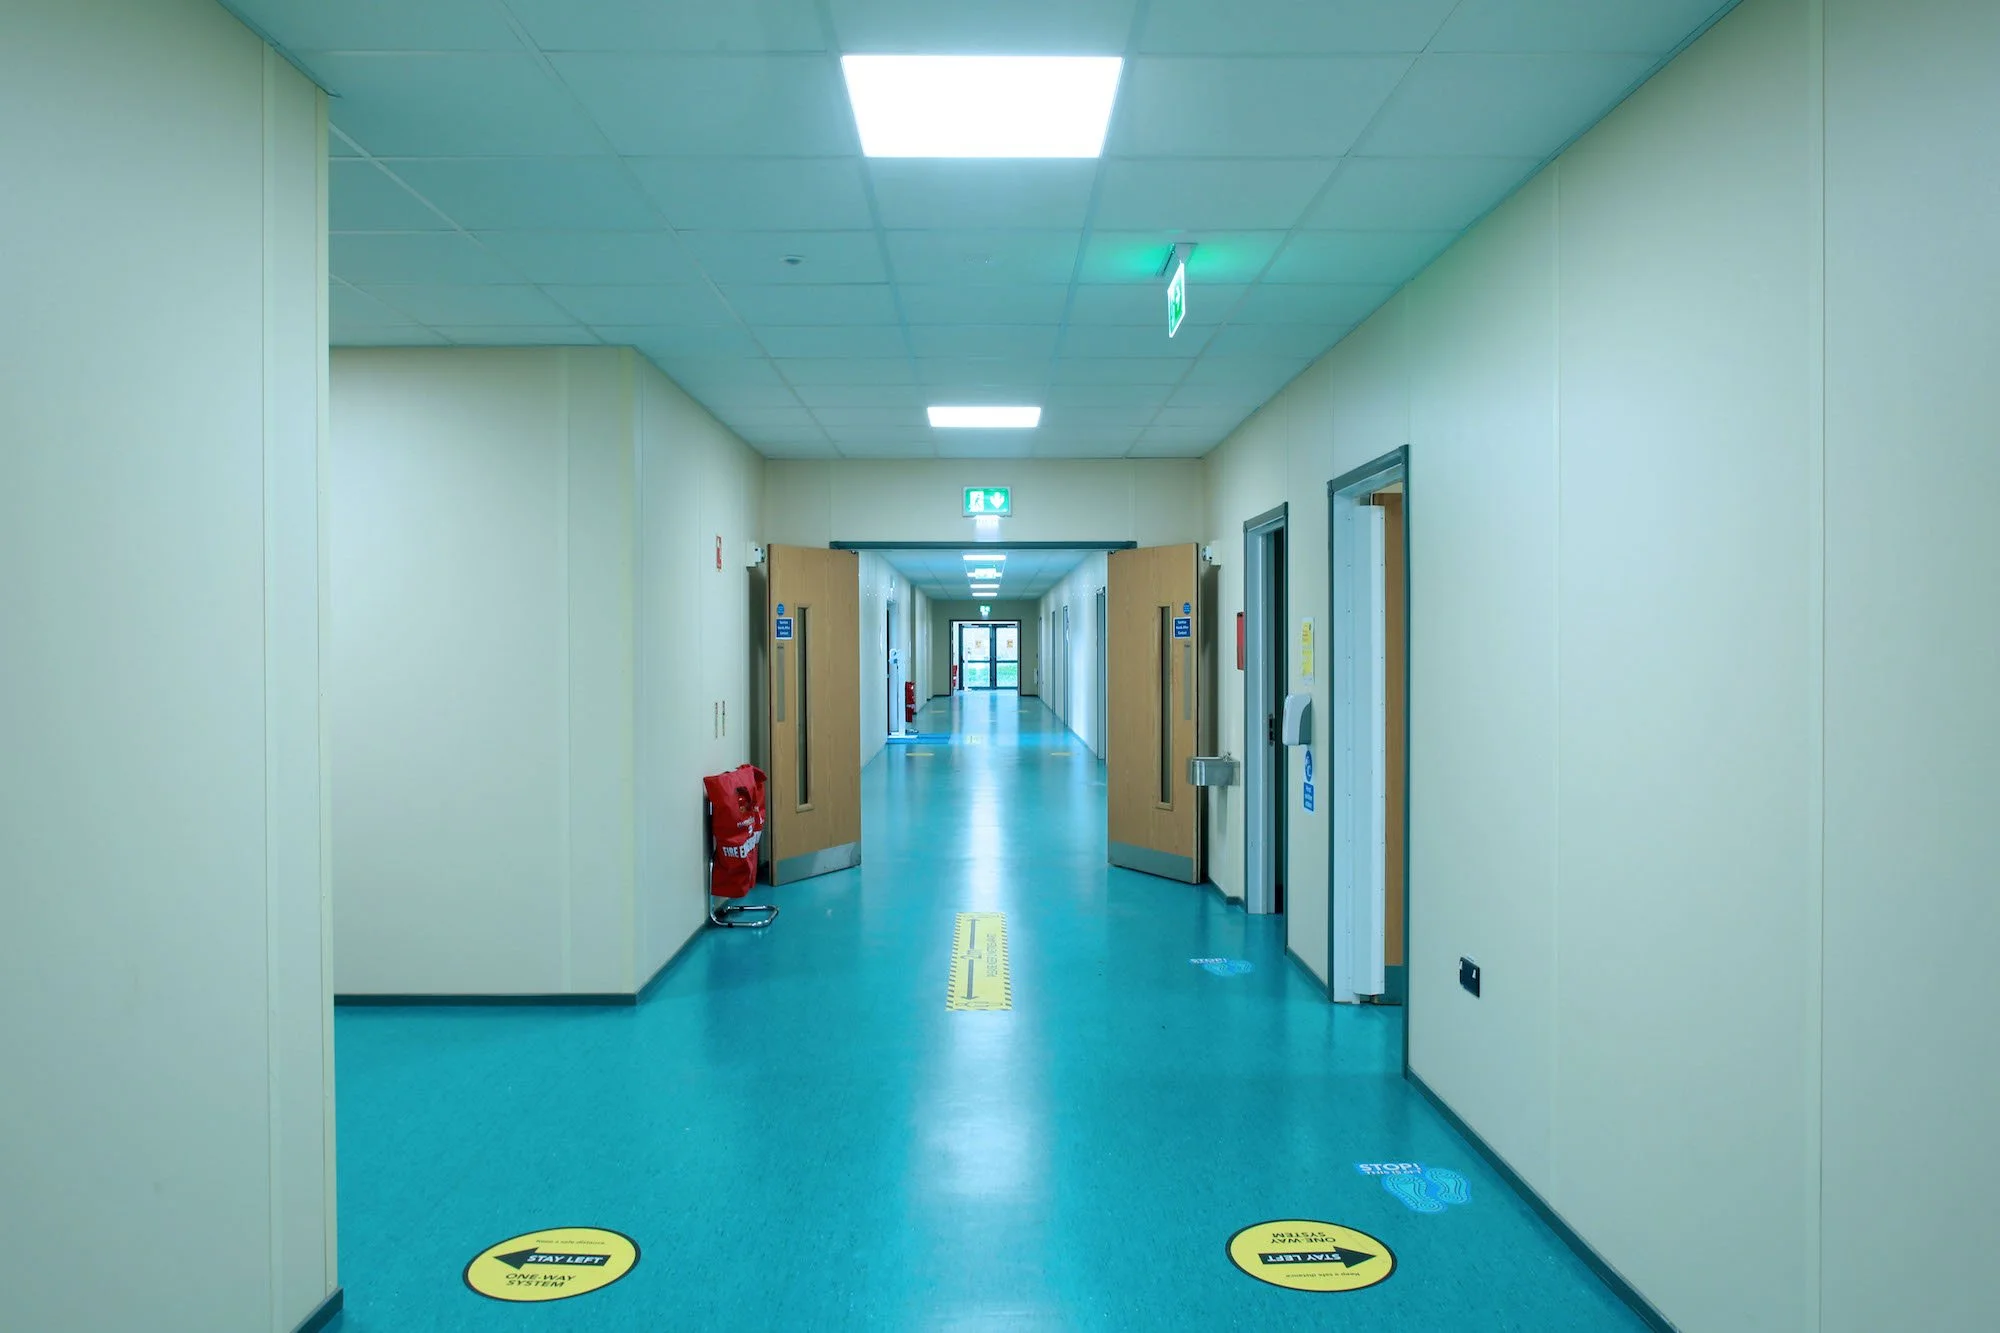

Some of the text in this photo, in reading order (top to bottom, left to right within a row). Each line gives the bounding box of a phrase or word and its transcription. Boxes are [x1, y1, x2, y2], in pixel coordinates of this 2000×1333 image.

[722, 846, 739, 858] FIRE
[1359, 1163, 1422, 1171] STOP!
[527, 1255, 604, 1264] STAY LEFT
[506, 1280, 565, 1288] SYSTEM
